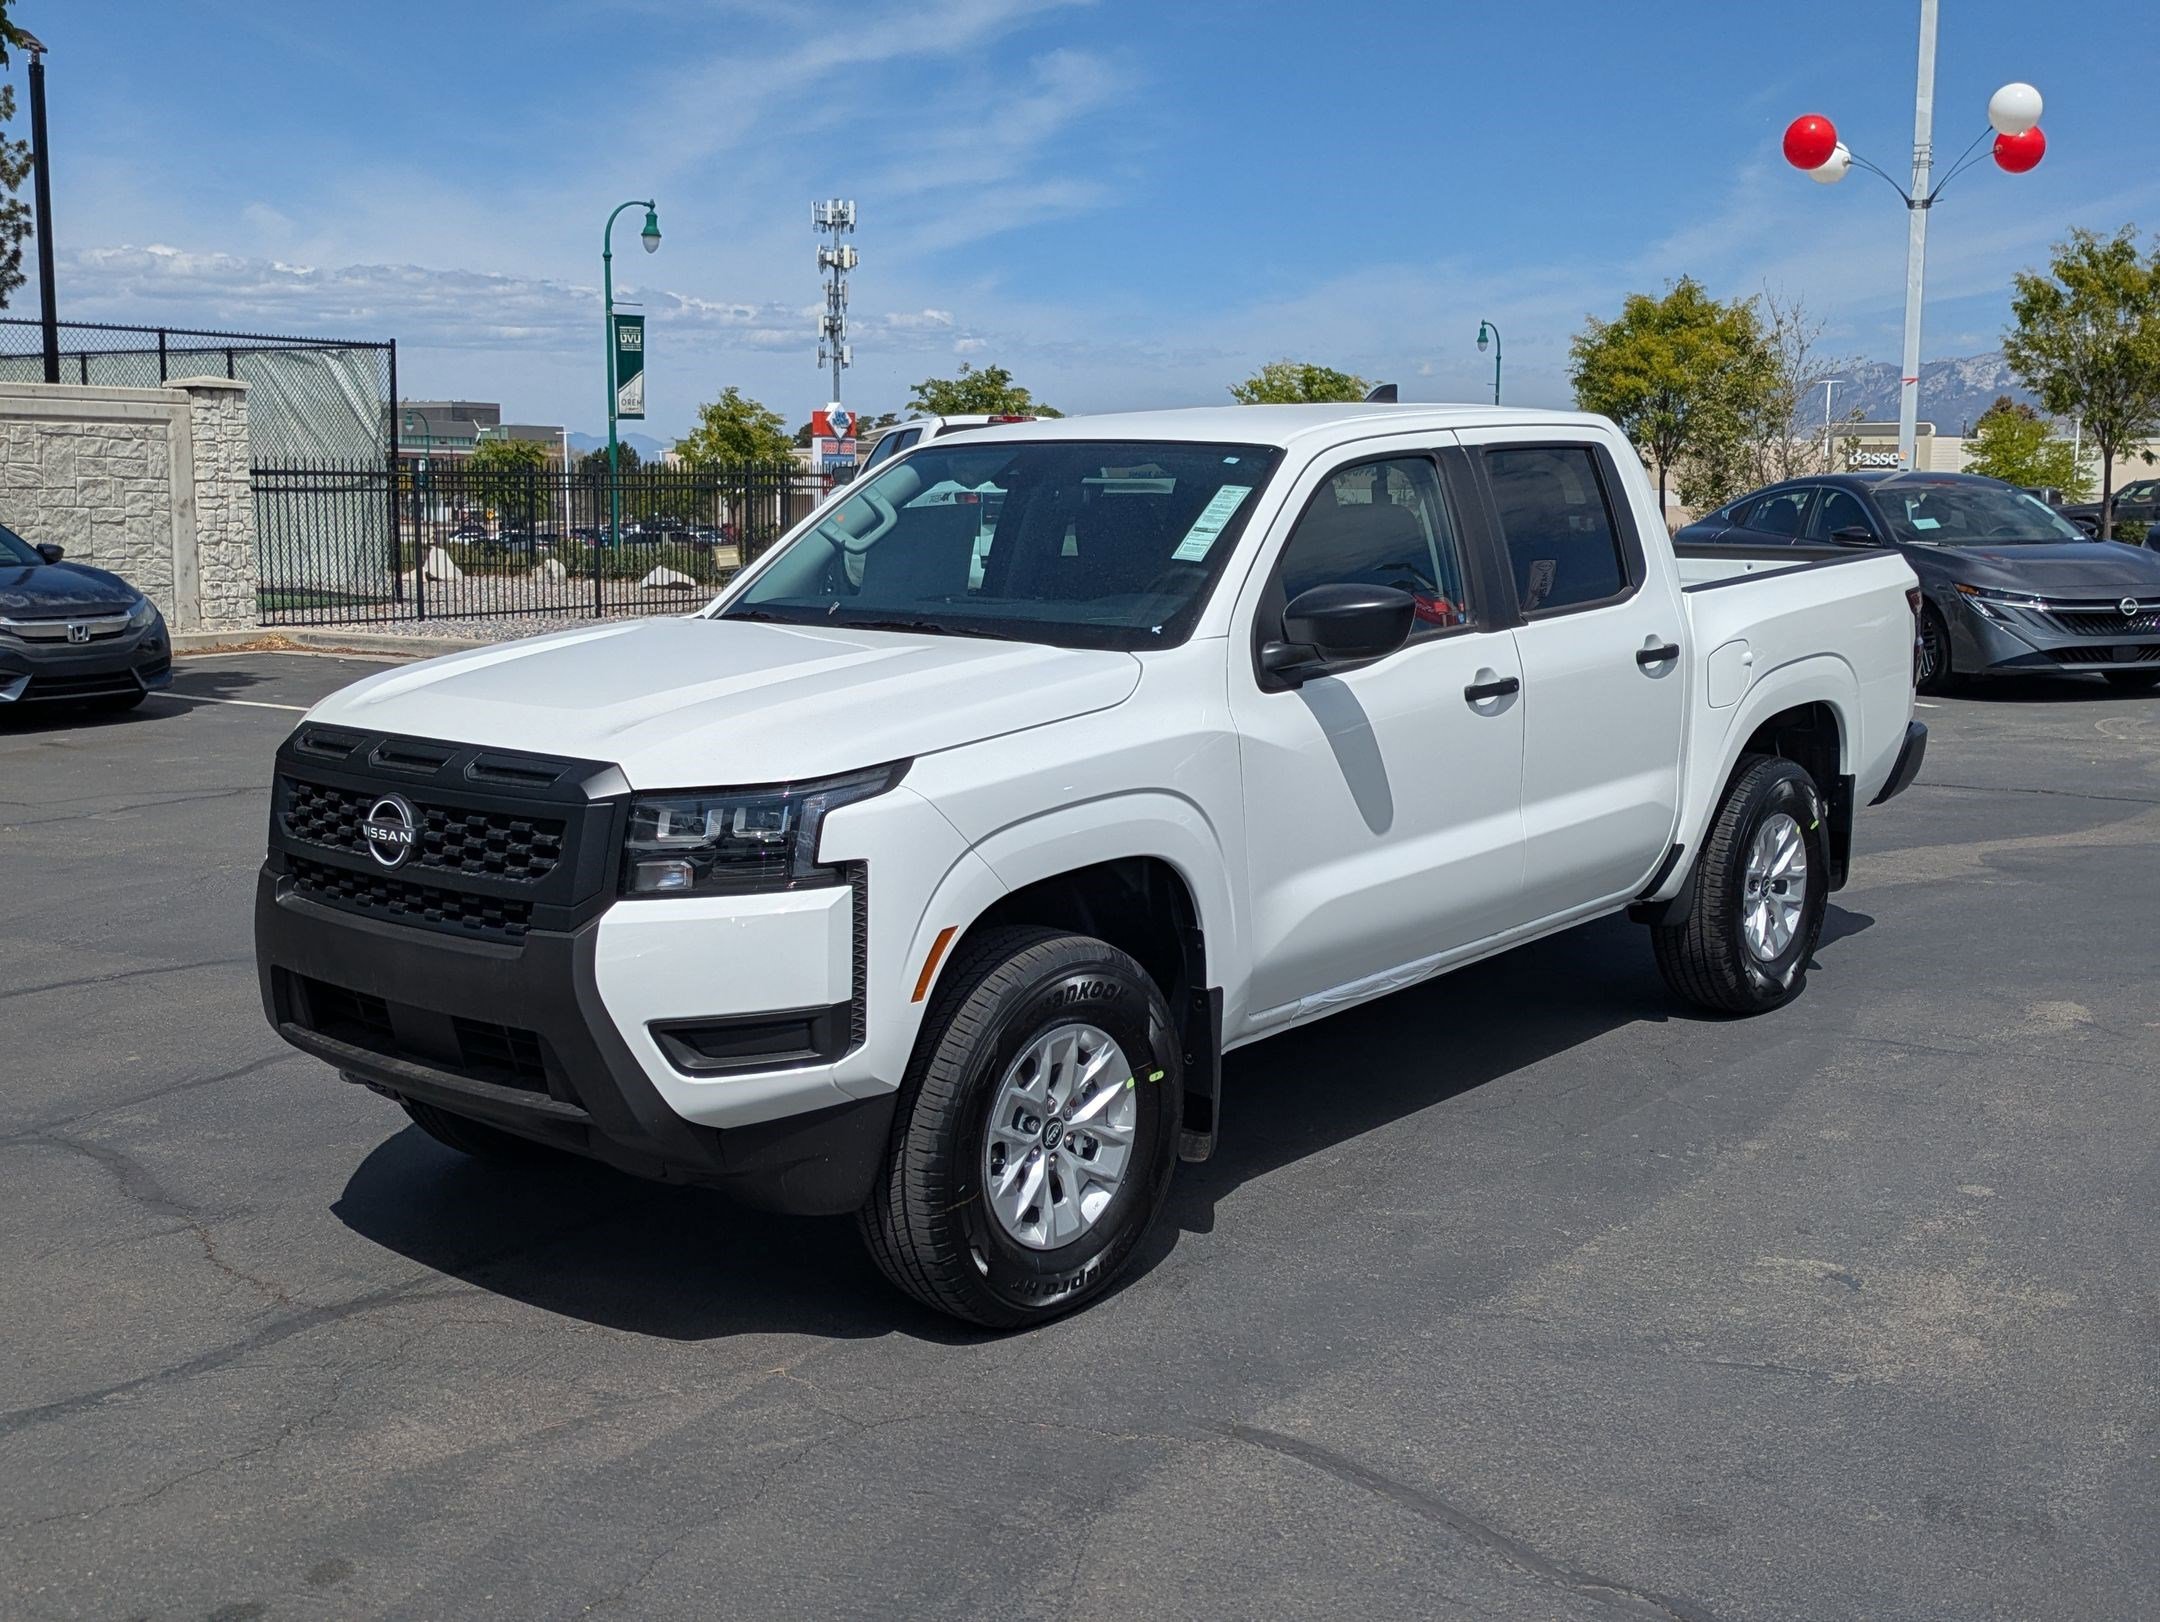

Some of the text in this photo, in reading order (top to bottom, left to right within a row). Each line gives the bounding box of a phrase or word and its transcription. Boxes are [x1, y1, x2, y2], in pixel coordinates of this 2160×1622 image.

[620, 334, 641, 344] UVU
[1848, 447, 1899, 466] Basse
[362, 823, 412, 843] NISSAN
